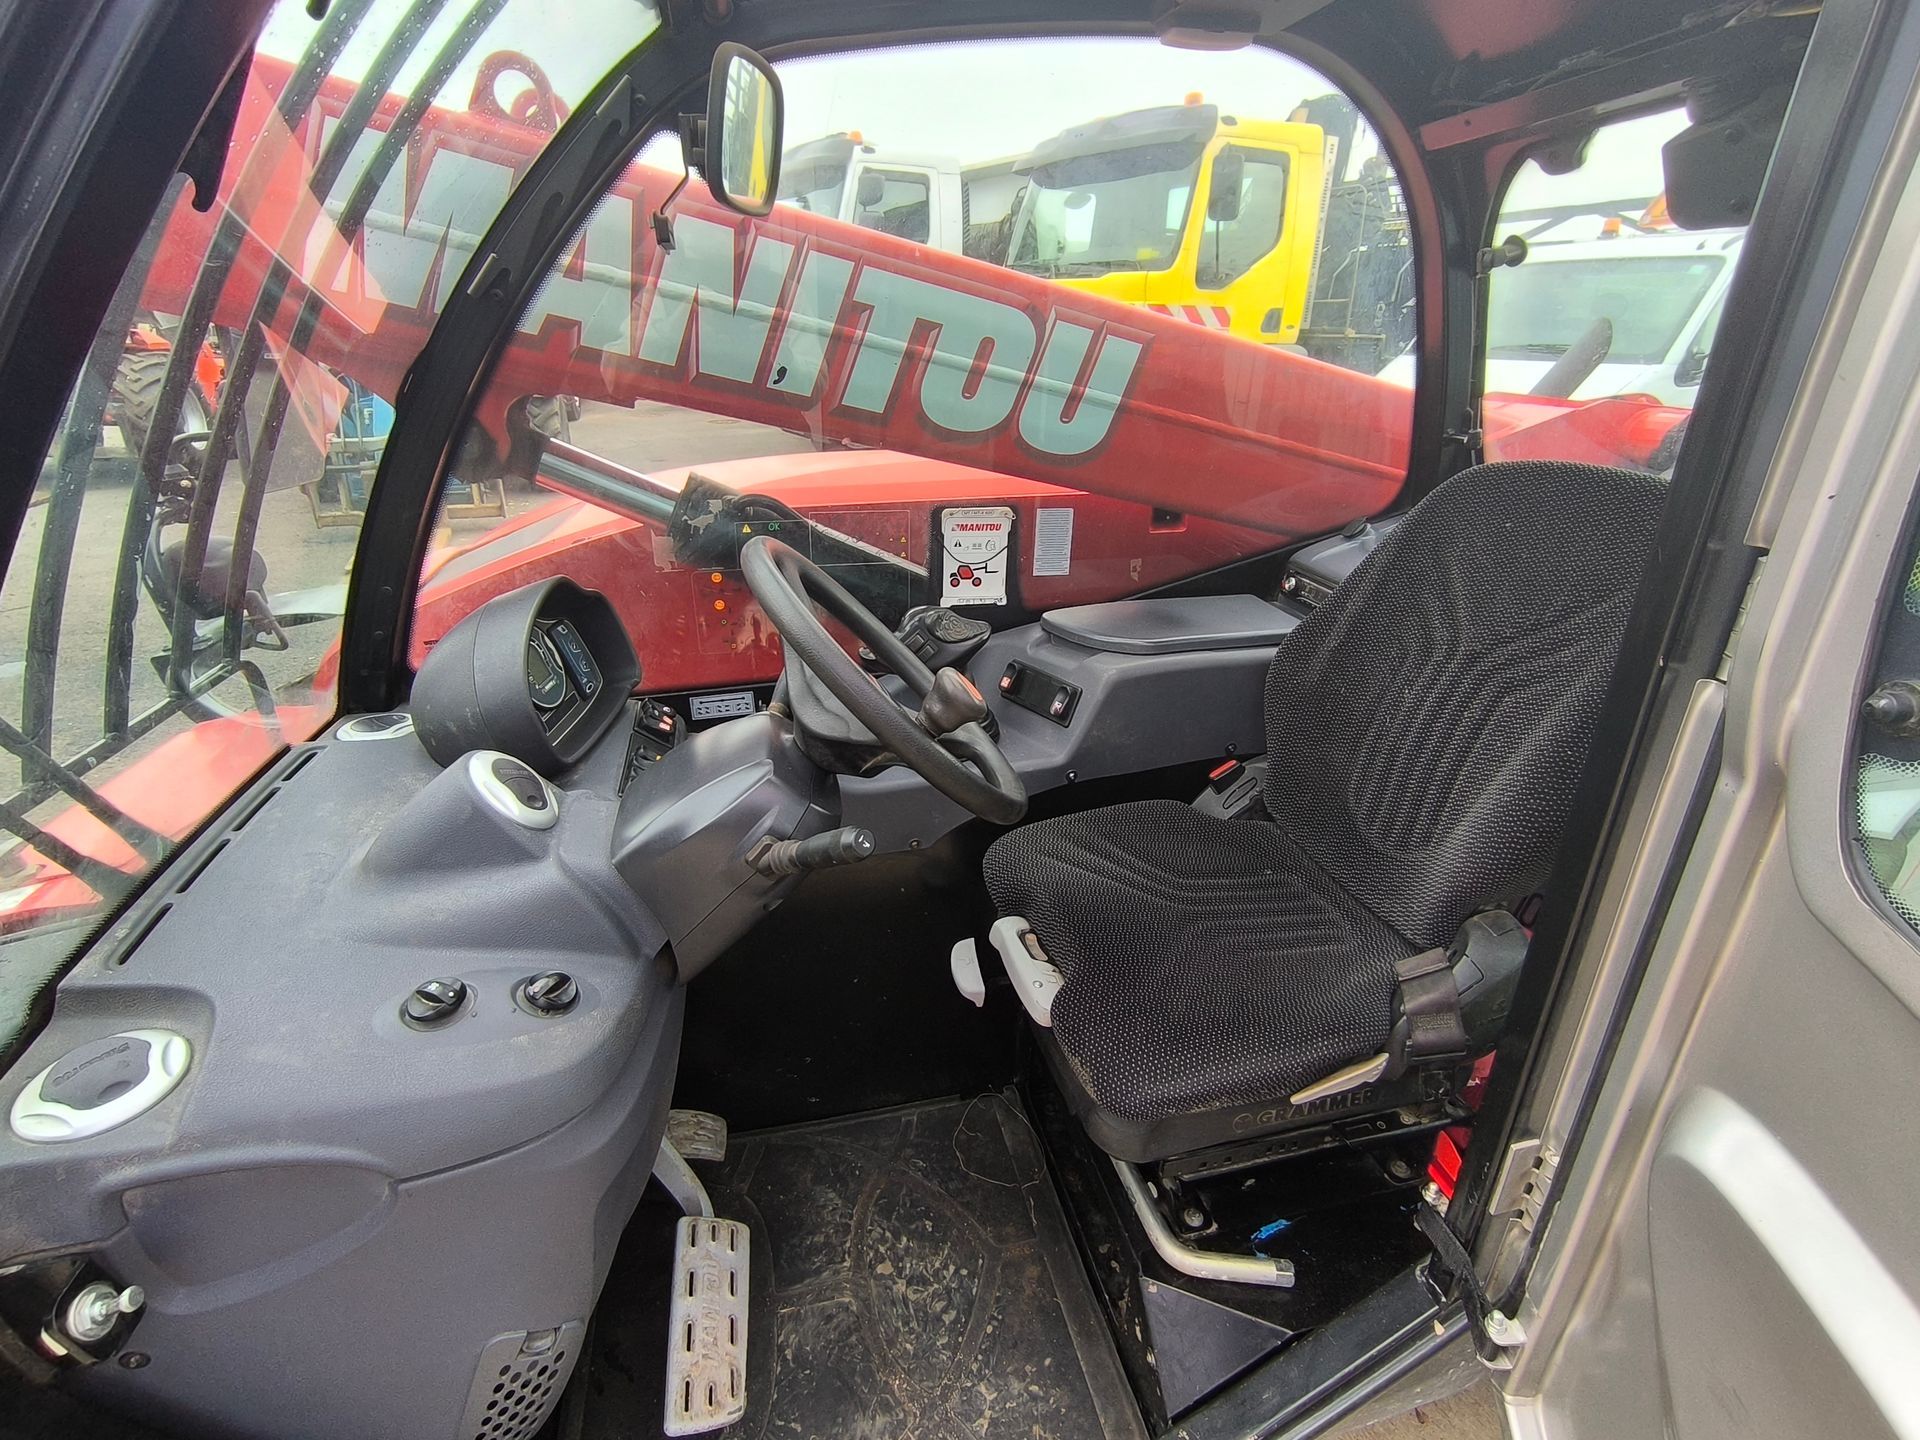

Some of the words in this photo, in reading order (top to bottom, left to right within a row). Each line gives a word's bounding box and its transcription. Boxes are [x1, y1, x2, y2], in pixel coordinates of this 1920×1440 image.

[302, 115, 1144, 456] MANITOU
[768, 521, 780, 531] OK
[959, 523, 1002, 531] MANITOU
[1256, 1087, 1374, 1126] GRAMMER
